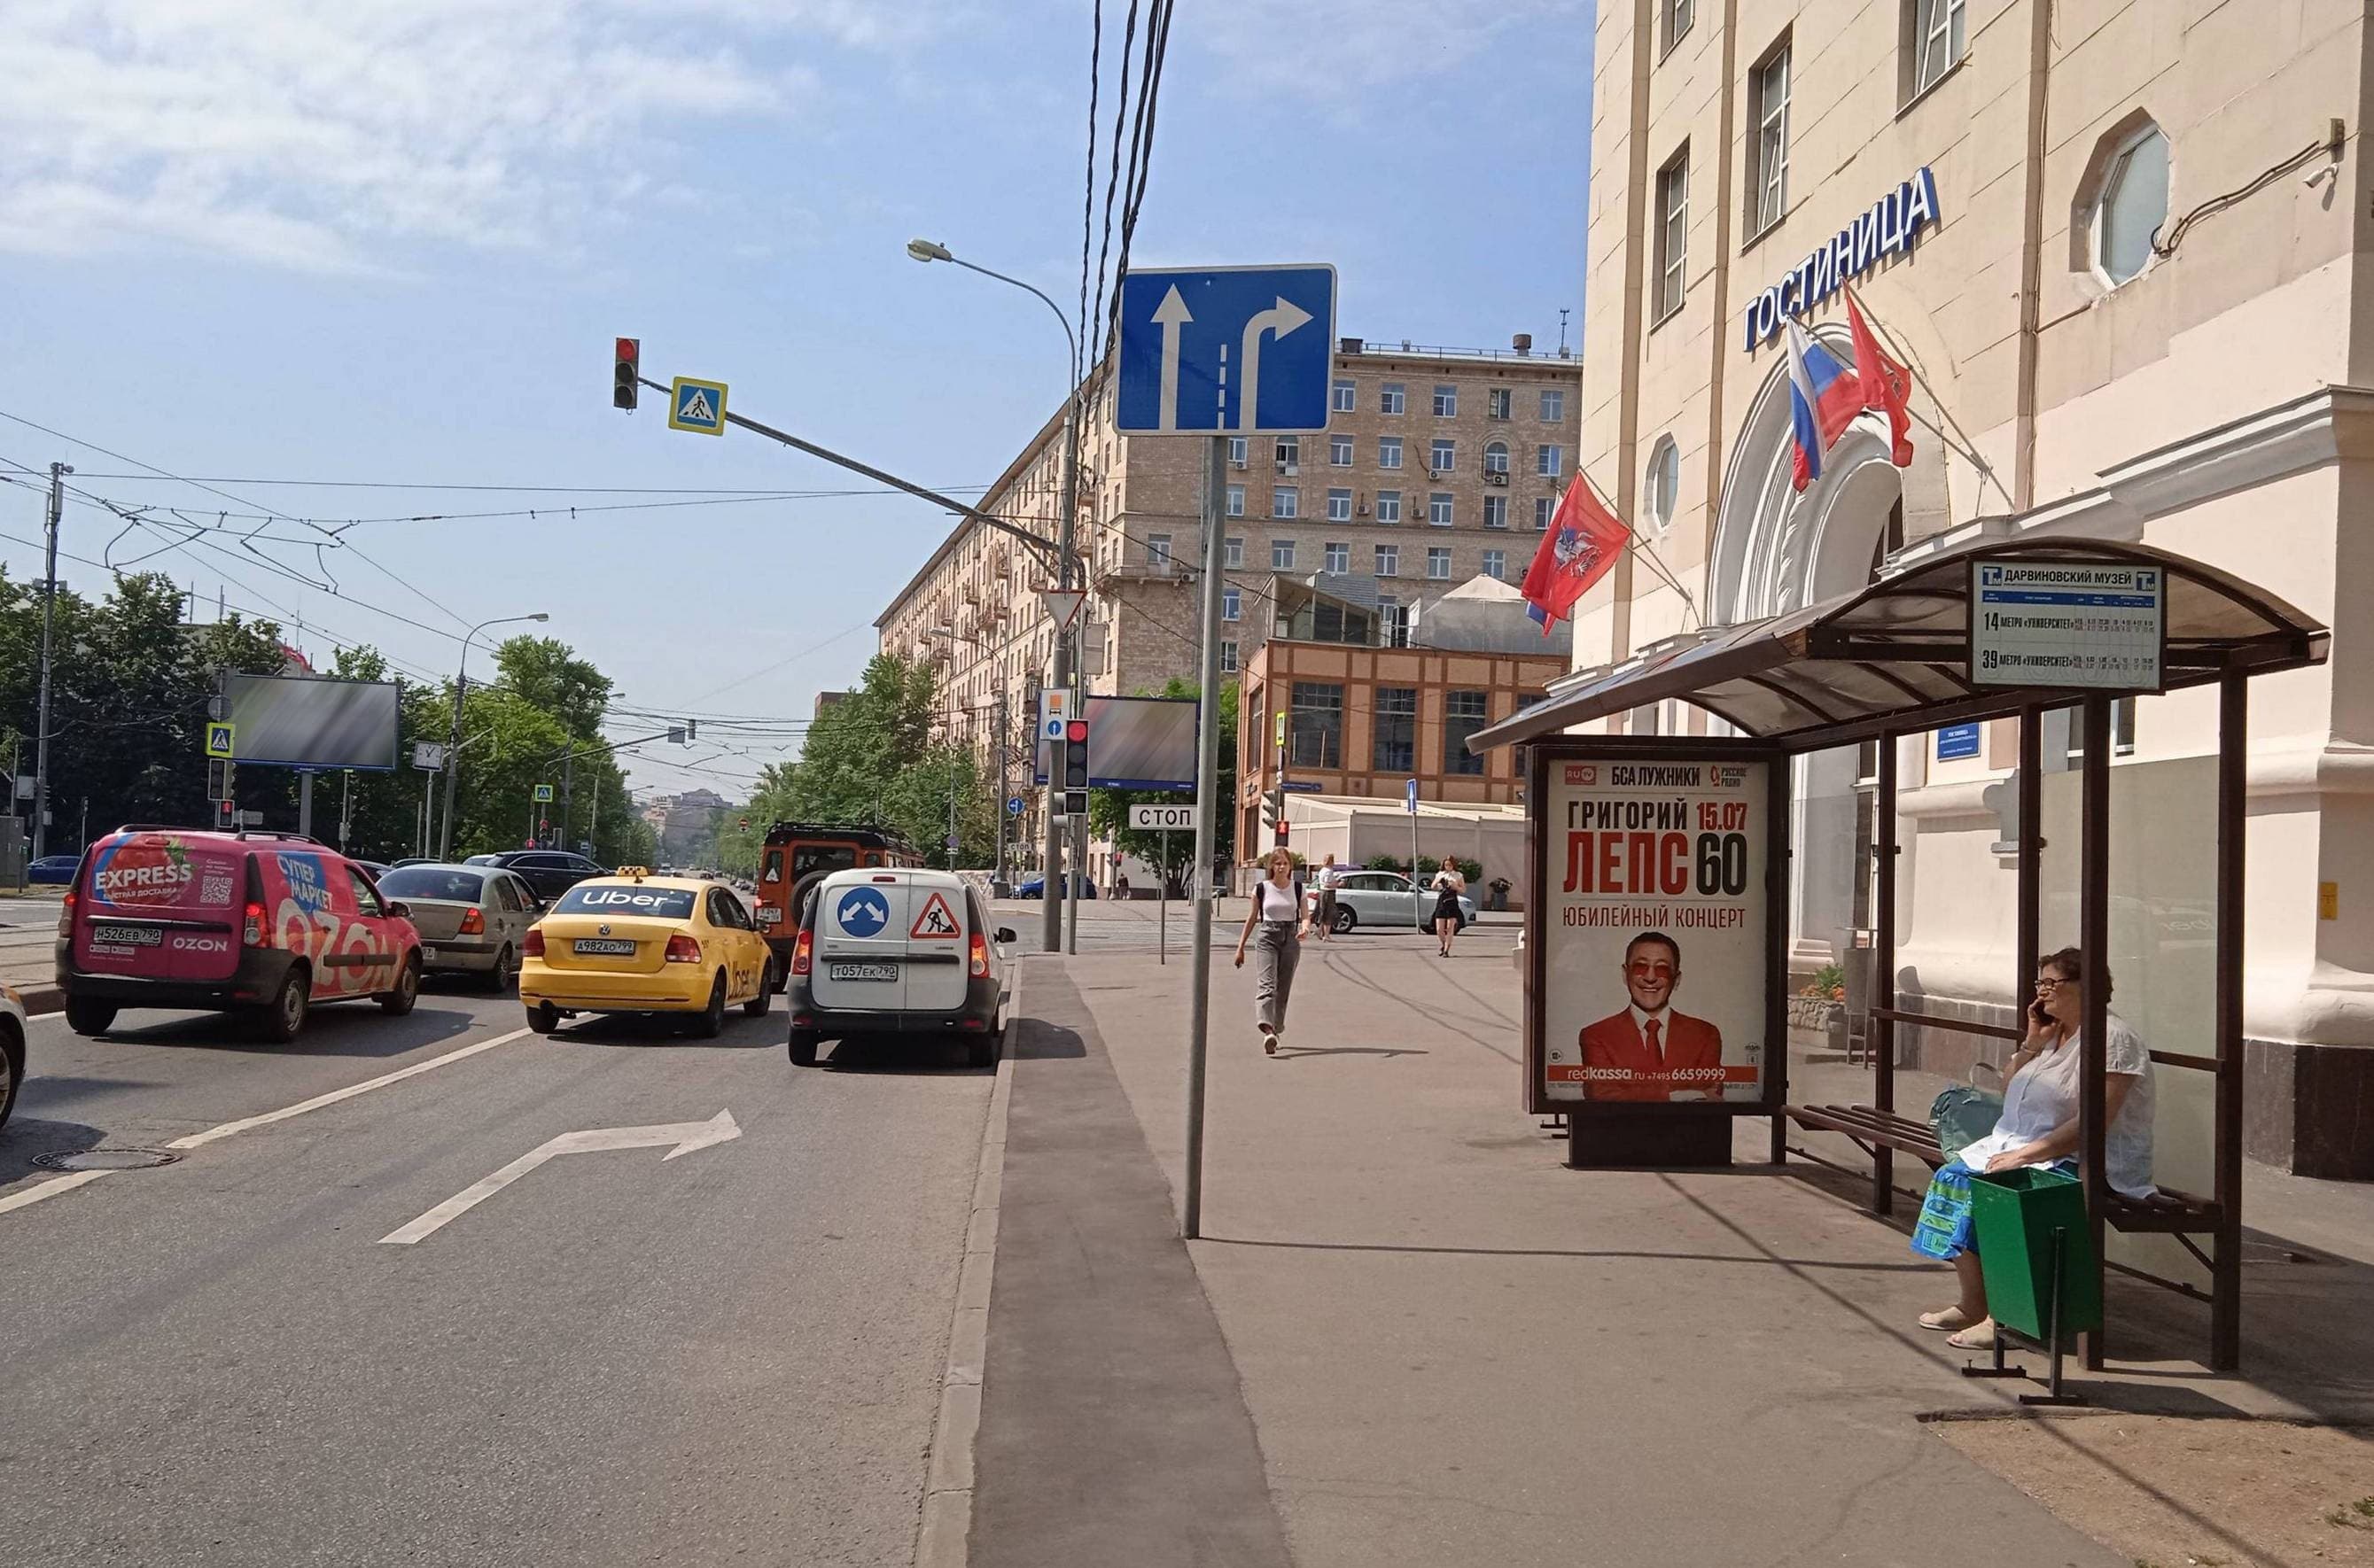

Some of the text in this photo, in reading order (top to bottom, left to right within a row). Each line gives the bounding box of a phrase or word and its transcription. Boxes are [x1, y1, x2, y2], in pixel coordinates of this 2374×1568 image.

[1743, 166, 1939, 352] ГОСТИНИЦА
[2004, 569, 2092, 584] ДАРВИНОВСКИЙ
[2095, 571, 2131, 585] МУЗЕЙ
[1985, 612, 1999, 631] 14
[2000, 617, 2022, 627] МЕТРО
[1982, 649, 1997, 669] 39
[1612, 766, 1701, 787] БСА ЛУЖНИКИ
[1139, 809, 1191, 826] СТОП
[1568, 798, 1747, 830] ГРИГОРИЙ 15.07
[276, 855, 315, 884] СУПЕР
[1563, 831, 1747, 896] ЛЕПС 60
[95, 864, 193, 890] EXPRESS
[137, 887, 178, 898] ДОСТАВКА
[291, 879, 333, 911] МАРКЕТ
[1563, 904, 1746, 929] ЮБИЛЕЙНЫЙ КОНЦЕРТ
[173, 937, 228, 952] OZON
[276, 897, 402, 992] OZON
[1671, 1067, 1726, 1081] 6659999
